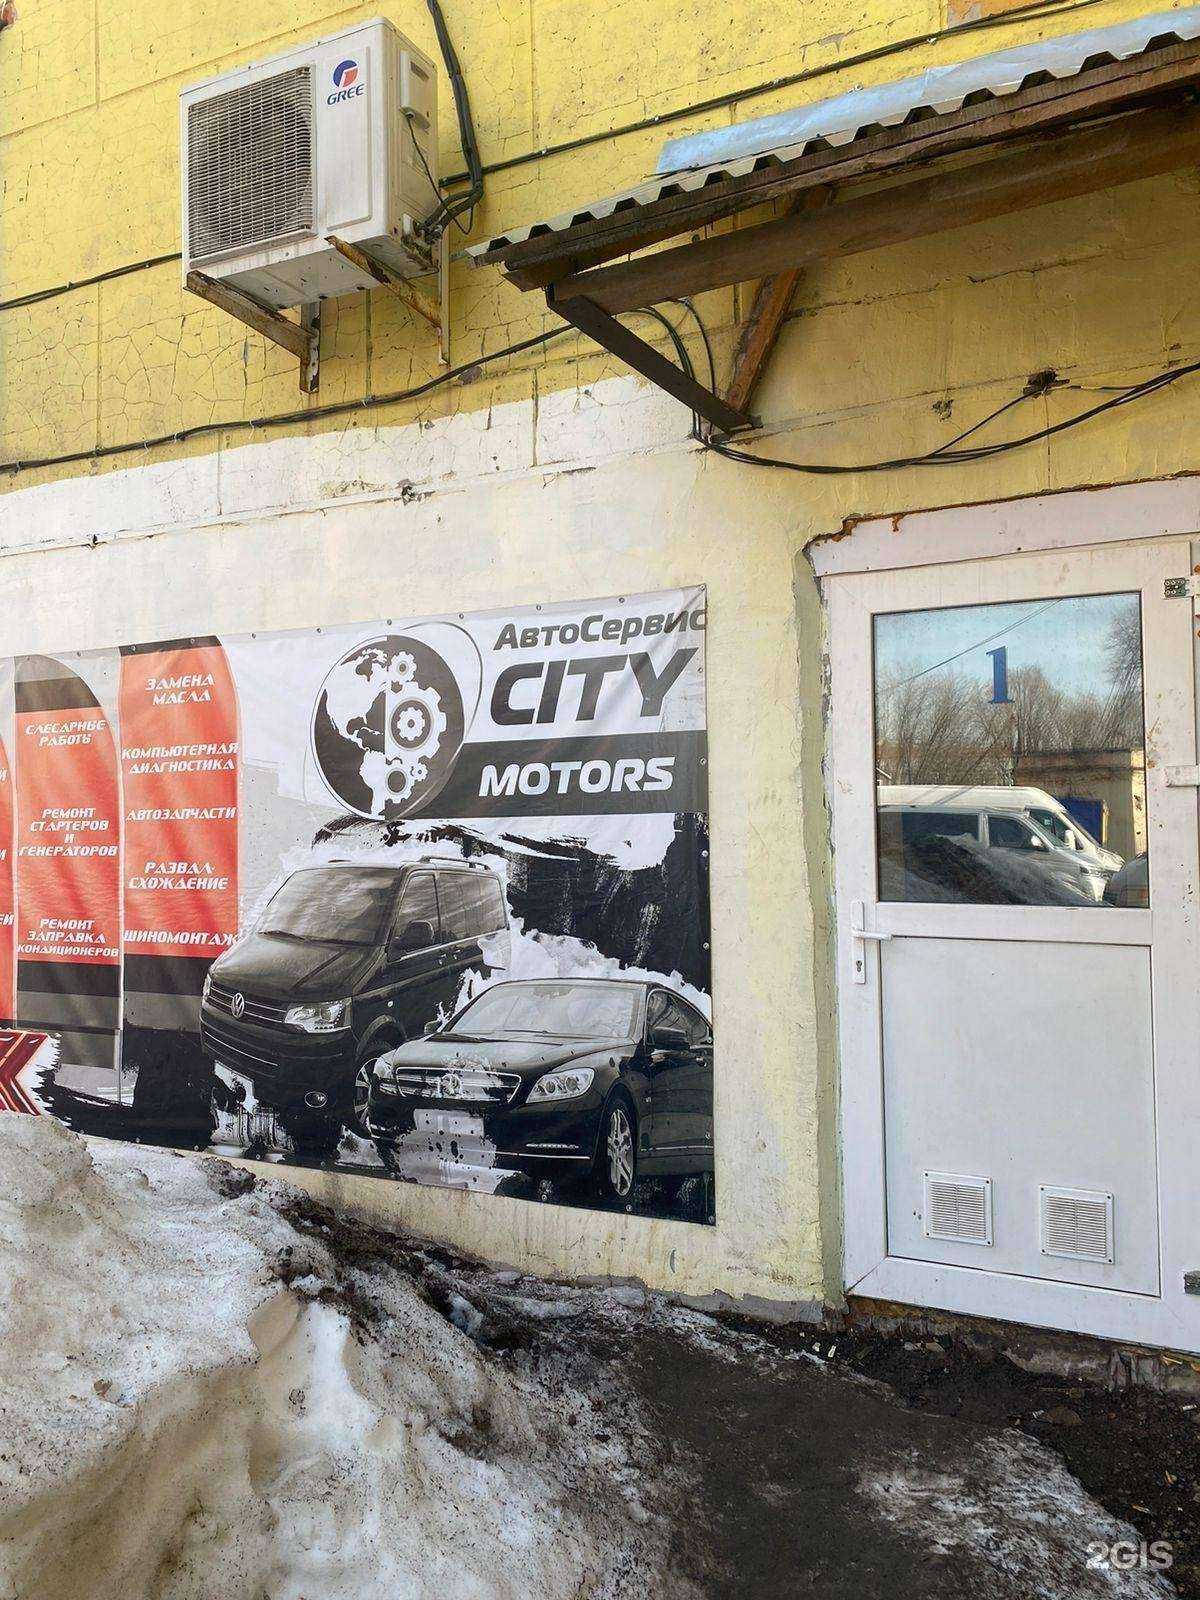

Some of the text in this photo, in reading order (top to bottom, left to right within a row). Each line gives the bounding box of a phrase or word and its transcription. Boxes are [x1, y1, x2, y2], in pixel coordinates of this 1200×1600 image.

[327, 83, 365, 105] GREE
[493, 609, 706, 651] АвтоСервис
[145, 673, 215, 691] ЗАМЕНА
[986, 645, 1015, 703] 1
[490, 647, 699, 726] CITY
[152, 690, 212, 706] МАСЛА
[25, 719, 107, 735] СЛЕСАРНЫЕ
[39, 734, 92, 747] РАБОТЫ
[121, 742, 240, 761] КОМПЬЮТЕРНАЯ
[128, 758, 236, 775] ДИАГНОСТИКА
[478, 756, 676, 797] MOTORS
[41, 807, 96, 819] РЕМОНТ
[125, 806, 237, 821] АВТОЗАПЧАСТИ
[29, 820, 110, 833] СТАРТЕРОВ
[63, 833, 76, 844] И
[17, 846, 118, 857] ГЕНЕРАТОРОВ
[127, 877, 229, 891] СХОЖДЕНИЕ
[39, 918, 95, 931] РЕМОНТ
[27, 930, 107, 944] ЗАПРАВКА
[123, 929, 240, 946] ШИНОМОНТАЖ
[16, 944, 119, 957] КОНДИЦИОНЕРОВ
